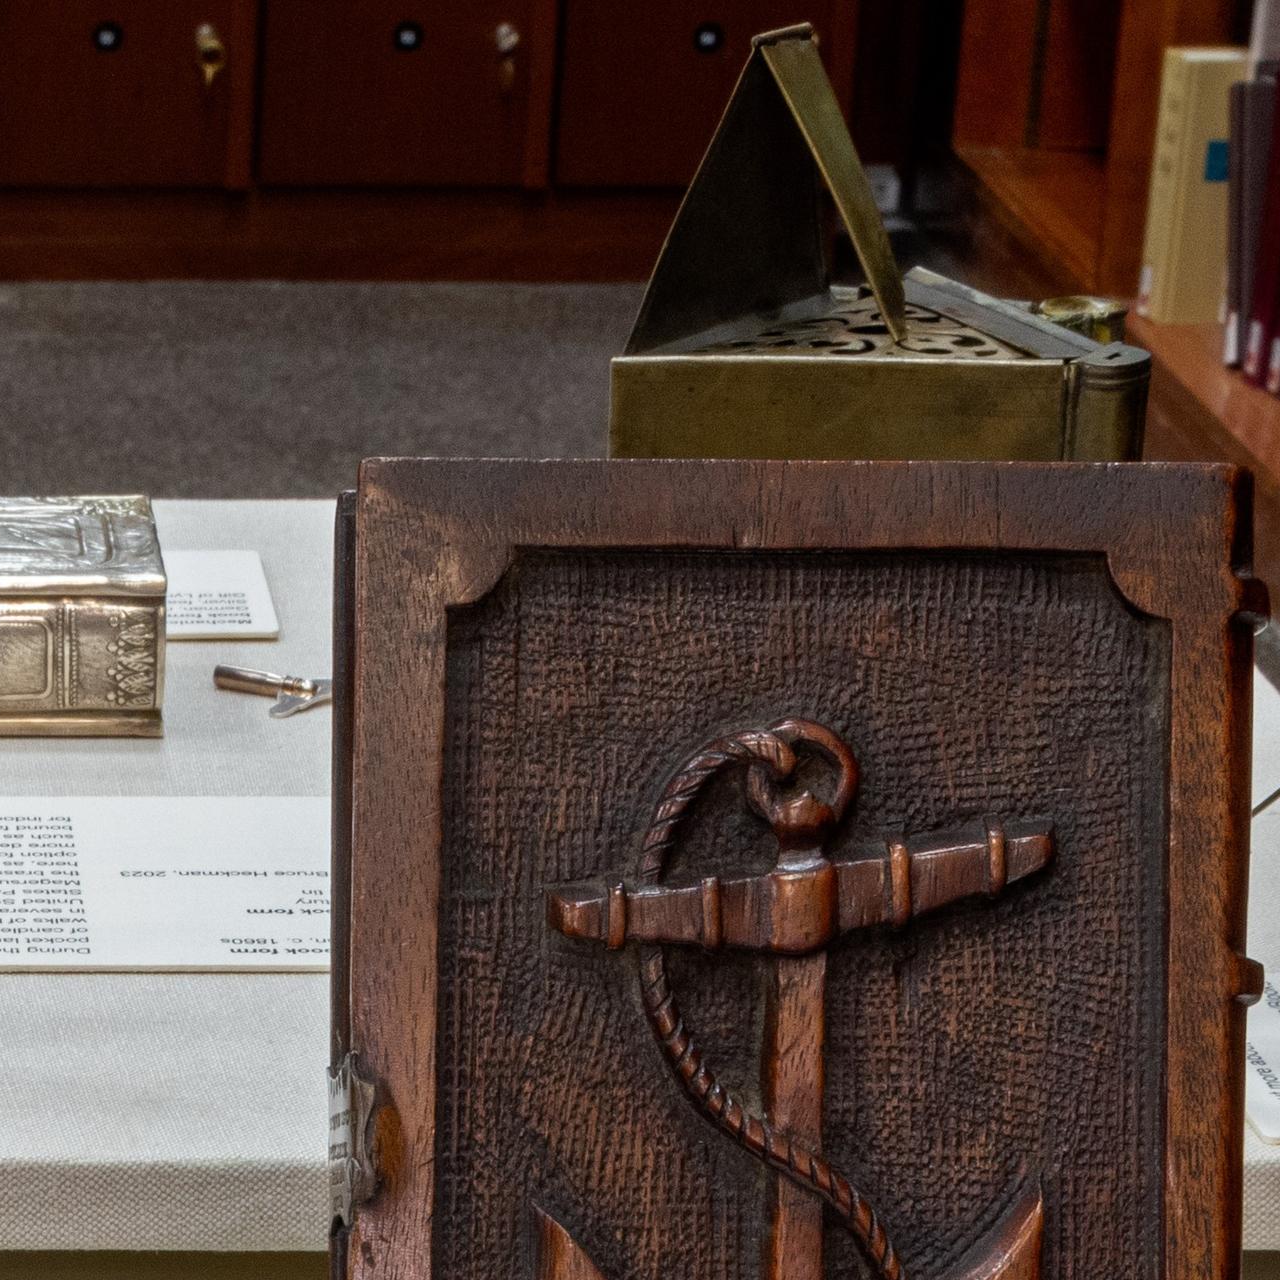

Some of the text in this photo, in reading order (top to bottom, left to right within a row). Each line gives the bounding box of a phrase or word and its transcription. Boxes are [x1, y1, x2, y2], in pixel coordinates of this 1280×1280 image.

[119, 869, 329, 878] Bruce Heckman, 2023
[219, 937, 279, 945] 1860s
[229, 947, 277, 955] form
